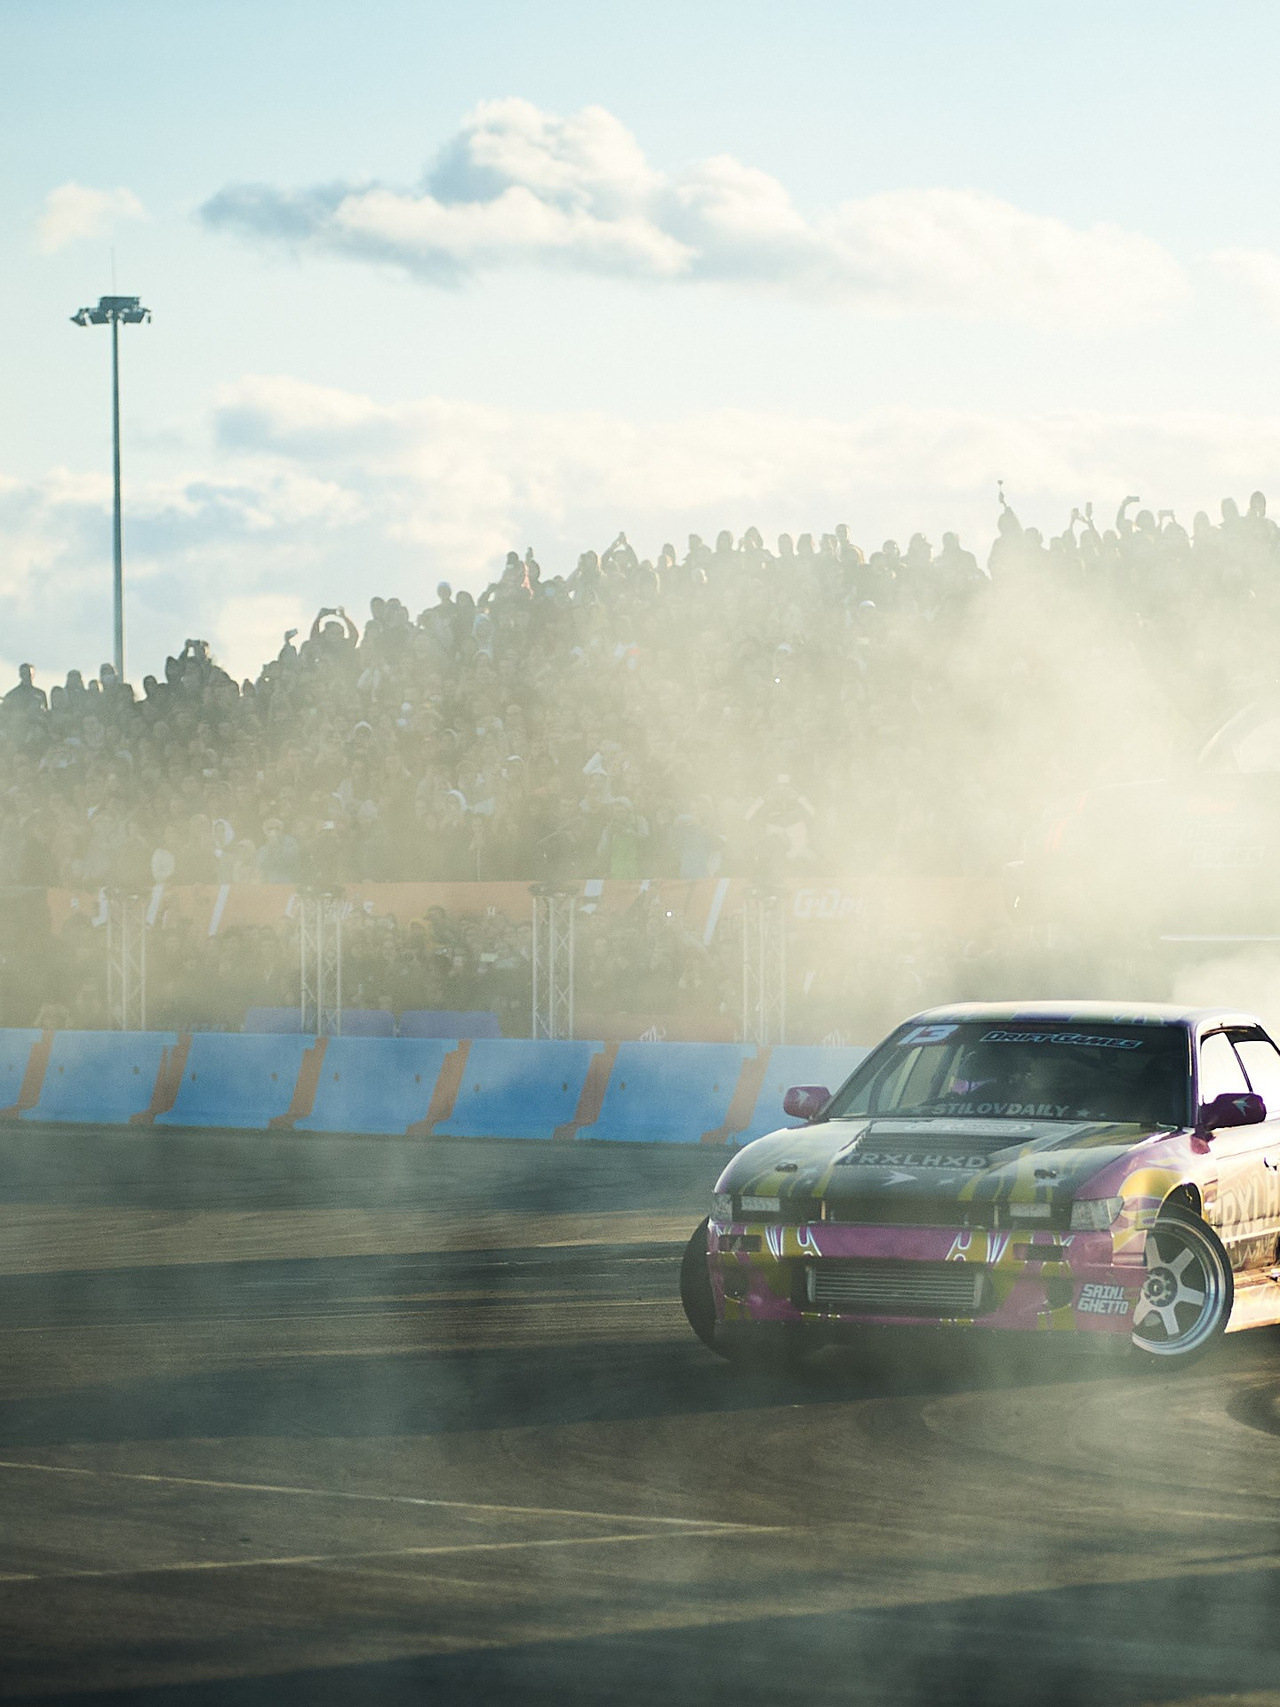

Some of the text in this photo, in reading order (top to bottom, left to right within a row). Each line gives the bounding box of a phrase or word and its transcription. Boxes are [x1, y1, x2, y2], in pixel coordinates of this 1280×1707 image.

[897, 1024, 959, 1046] 13
[931, 1102, 1070, 1117] STILOVDAILY
[1078, 1297, 1129, 1315] GHETTO
